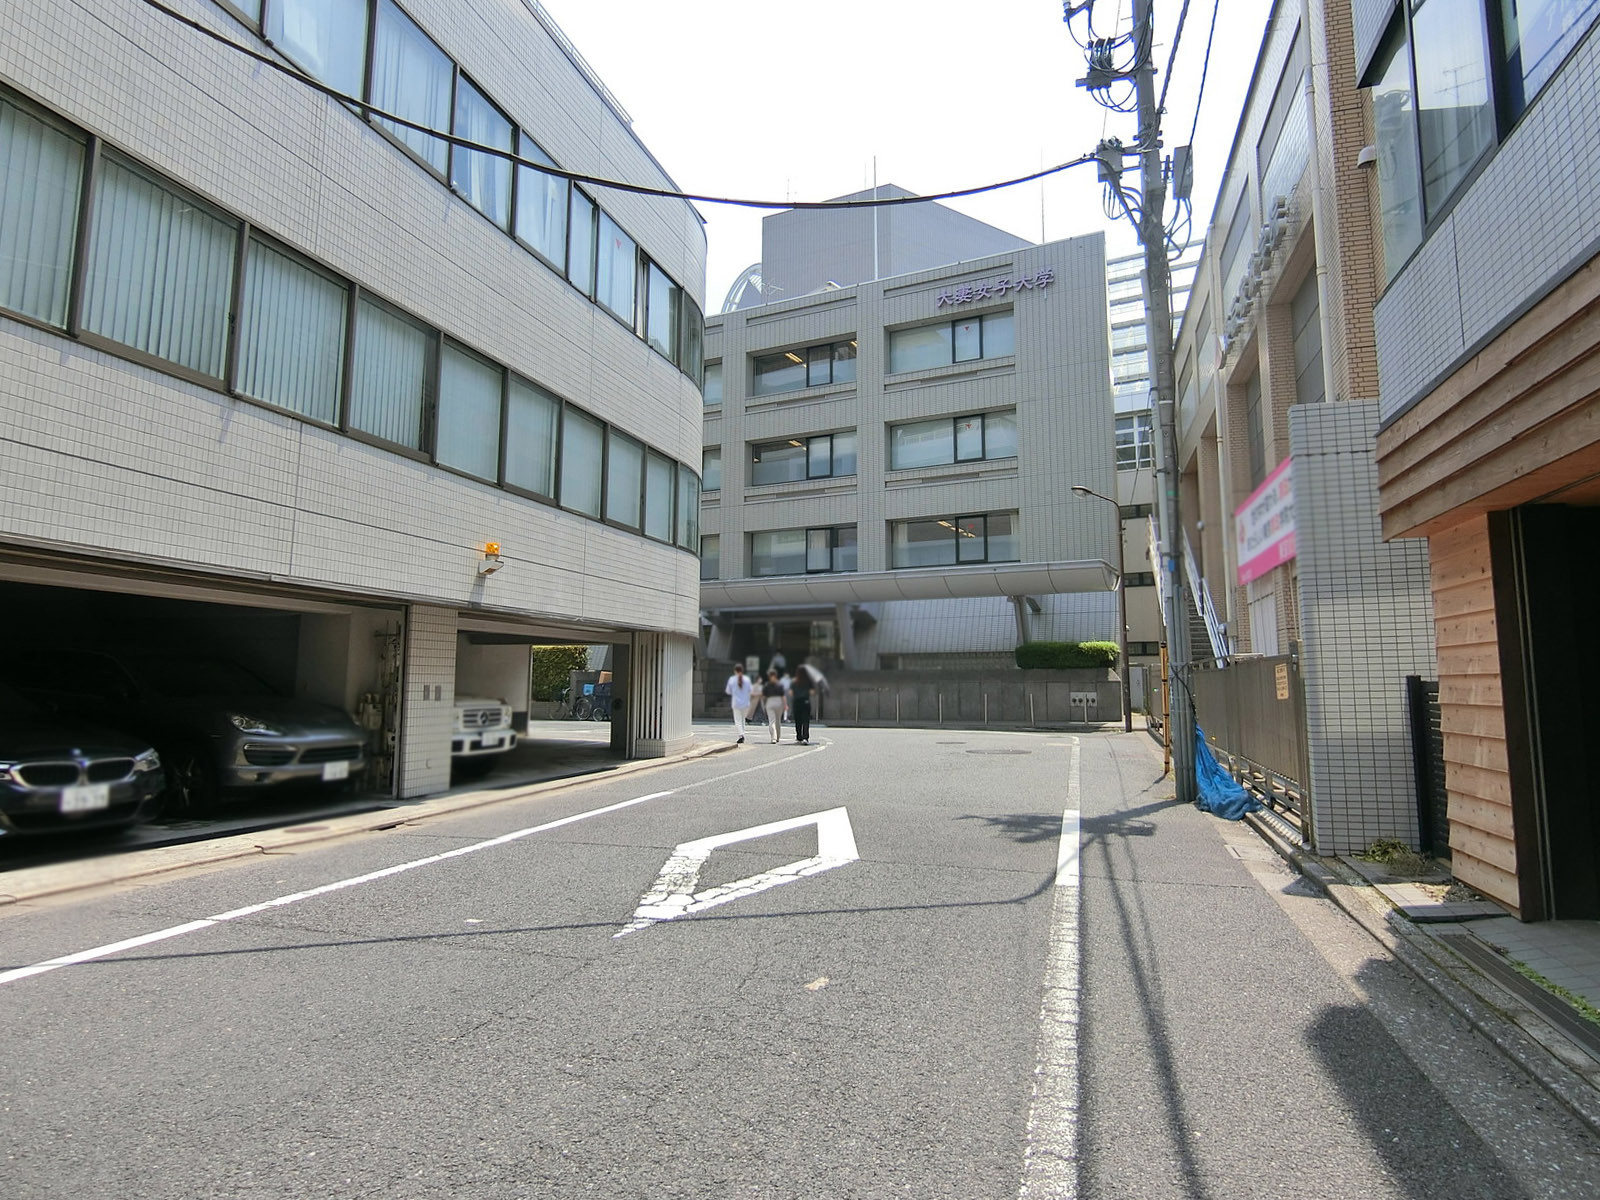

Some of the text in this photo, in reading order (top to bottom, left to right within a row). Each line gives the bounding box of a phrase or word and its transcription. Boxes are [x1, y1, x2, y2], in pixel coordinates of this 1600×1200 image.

[936, 268, 1055, 308] 大妻女子大学
